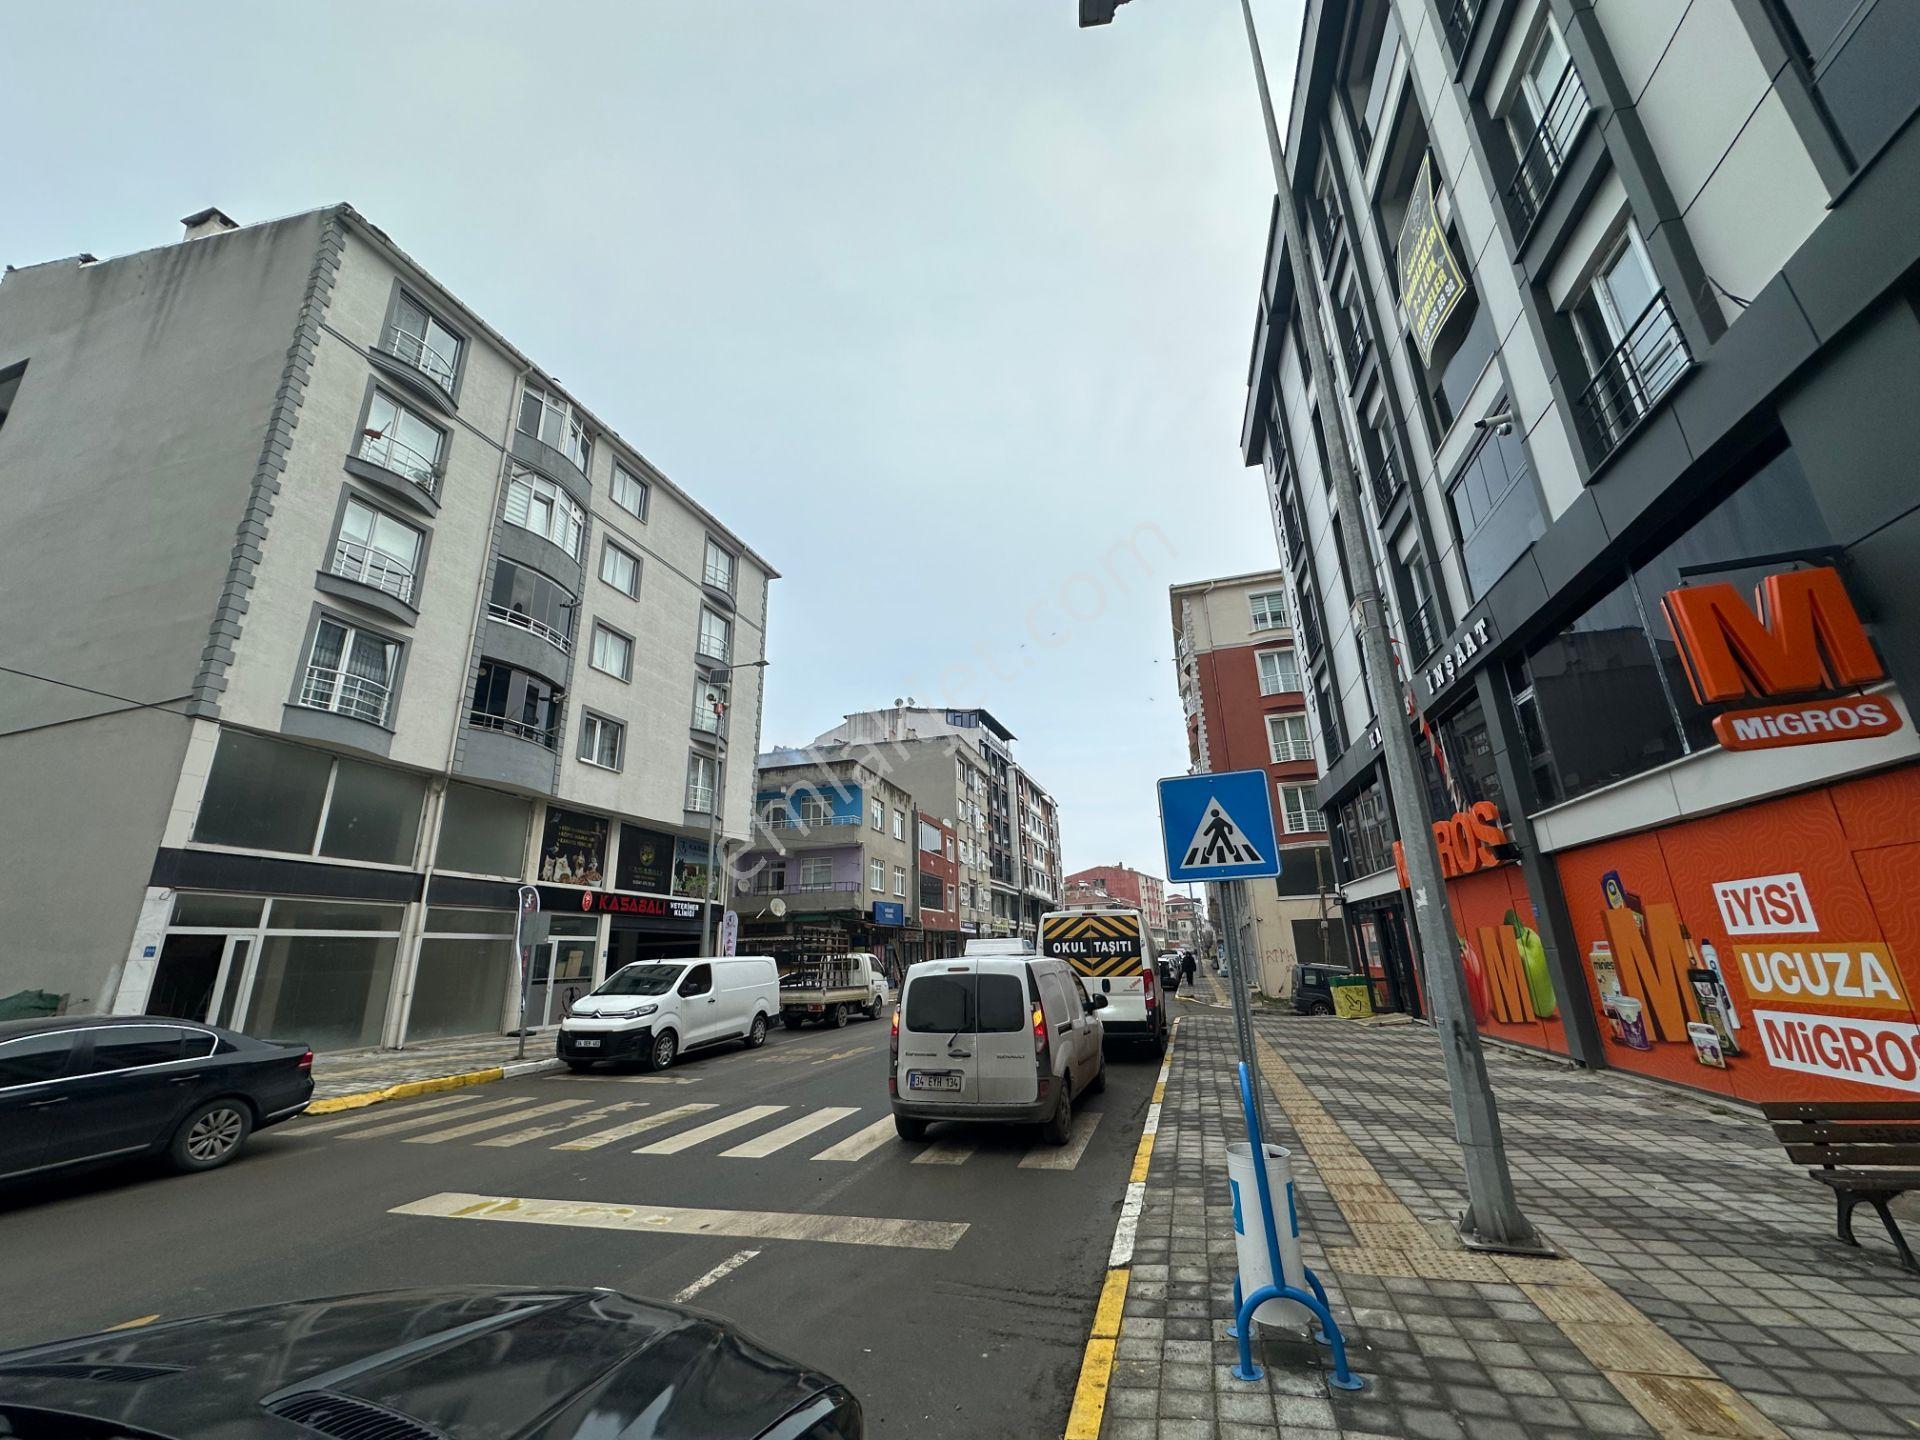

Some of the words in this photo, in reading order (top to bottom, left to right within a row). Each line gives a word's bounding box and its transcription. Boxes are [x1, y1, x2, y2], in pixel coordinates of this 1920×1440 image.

[1425, 617, 1489, 695] İNŞAAT
[1661, 566, 1884, 706] M
[1053, 941, 1087, 953] OKUL
[1093, 940, 1132, 955] TAŞITI
[1741, 952, 1901, 1000] UCUZA
[1763, 1019, 1920, 1082] MiGRO
[915, 1076, 924, 1086] 34
[928, 1076, 942, 1087] EYH
[946, 1078, 958, 1088] 134
